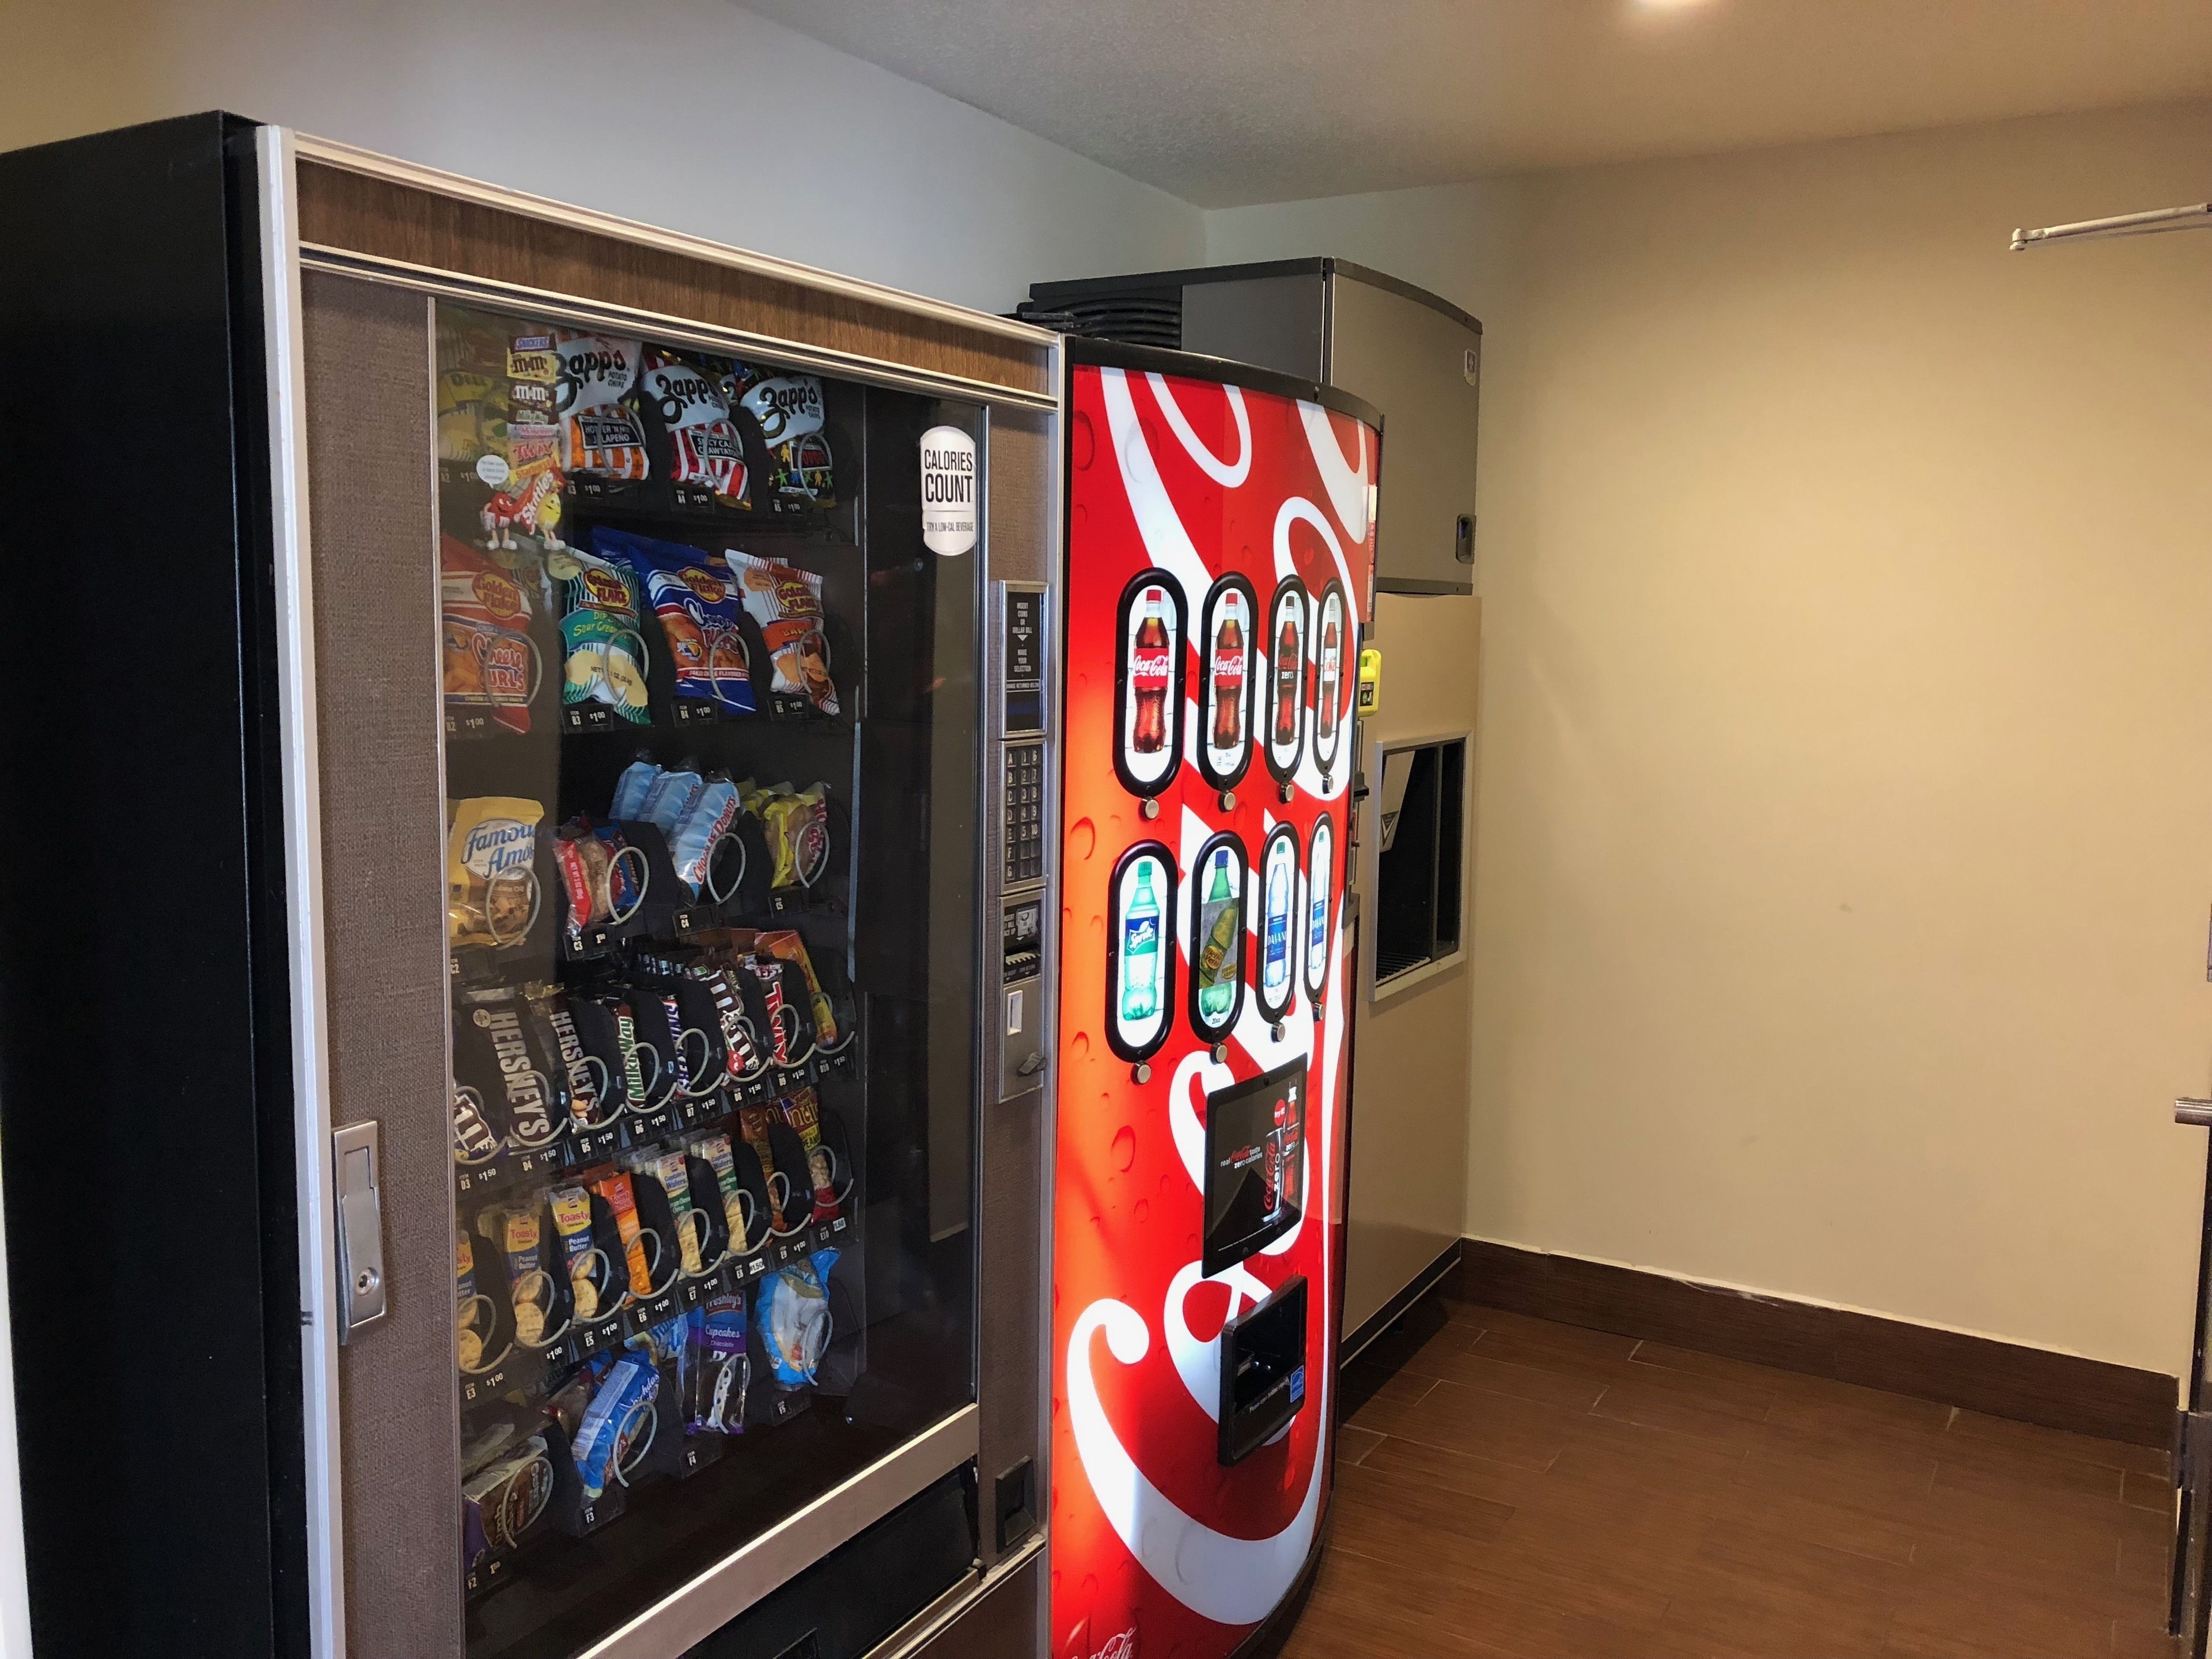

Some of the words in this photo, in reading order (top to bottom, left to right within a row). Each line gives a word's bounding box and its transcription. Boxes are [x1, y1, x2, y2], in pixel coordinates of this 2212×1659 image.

[593, 433, 630, 444] JLAPENO
[924, 449, 973, 472] CALORIES
[925, 472, 973, 503] COUNT
[938, 522, 955, 532] LOW-CAL
[956, 522, 974, 532] BEVERAGE
[573, 624, 595, 637] Sour
[1133, 654, 1169, 677] Coca-Cola
[1215, 654, 1243, 676] Coca-Cola
[1281, 671, 1294, 680] zero
[1008, 753, 1013, 764] A
[1023, 752, 1027, 763] 1
[1033, 750, 1037, 762] 6
[1008, 772, 1013, 783] B
[1022, 770, 1027, 782] 2
[1033, 769, 1037, 780] 7
[1022, 789, 1027, 800] 3
[1032, 787, 1037, 798] 8
[1022, 808, 1027, 819] 4
[1032, 806, 1037, 817] 9
[1022, 825, 1027, 837] 5
[1031, 824, 1038, 836] 10
[461, 825, 535, 864] Famou
[1007, 847, 1012, 859] F
[1129, 926, 1155, 949] Sprite
[618, 1016, 635, 1053] Way
[490, 1012, 550, 1138] HERSHEY'S
[635, 1124, 643, 1134] D6
[1220, 1155, 1231, 1167] real
[1234, 1158, 1247, 1169] zero
[1245, 1152, 1263, 1165] calories
[461, 1179, 471, 1190] D3
[558, 1210, 590, 1224] Toasty
[510, 1228, 537, 1239] Toasty
[568, 1235, 590, 1245] Peanut
[569, 1243, 588, 1252] Butter
[457, 1253, 471, 1264] sty
[518, 1254, 538, 1263] Peanut
[458, 1280, 472, 1290] anut
[638, 1312, 647, 1323] E6
[705, 1324, 741, 1339] Cupcakes
[585, 1336, 594, 1347] E5
[465, 1388, 476, 1400] E3
